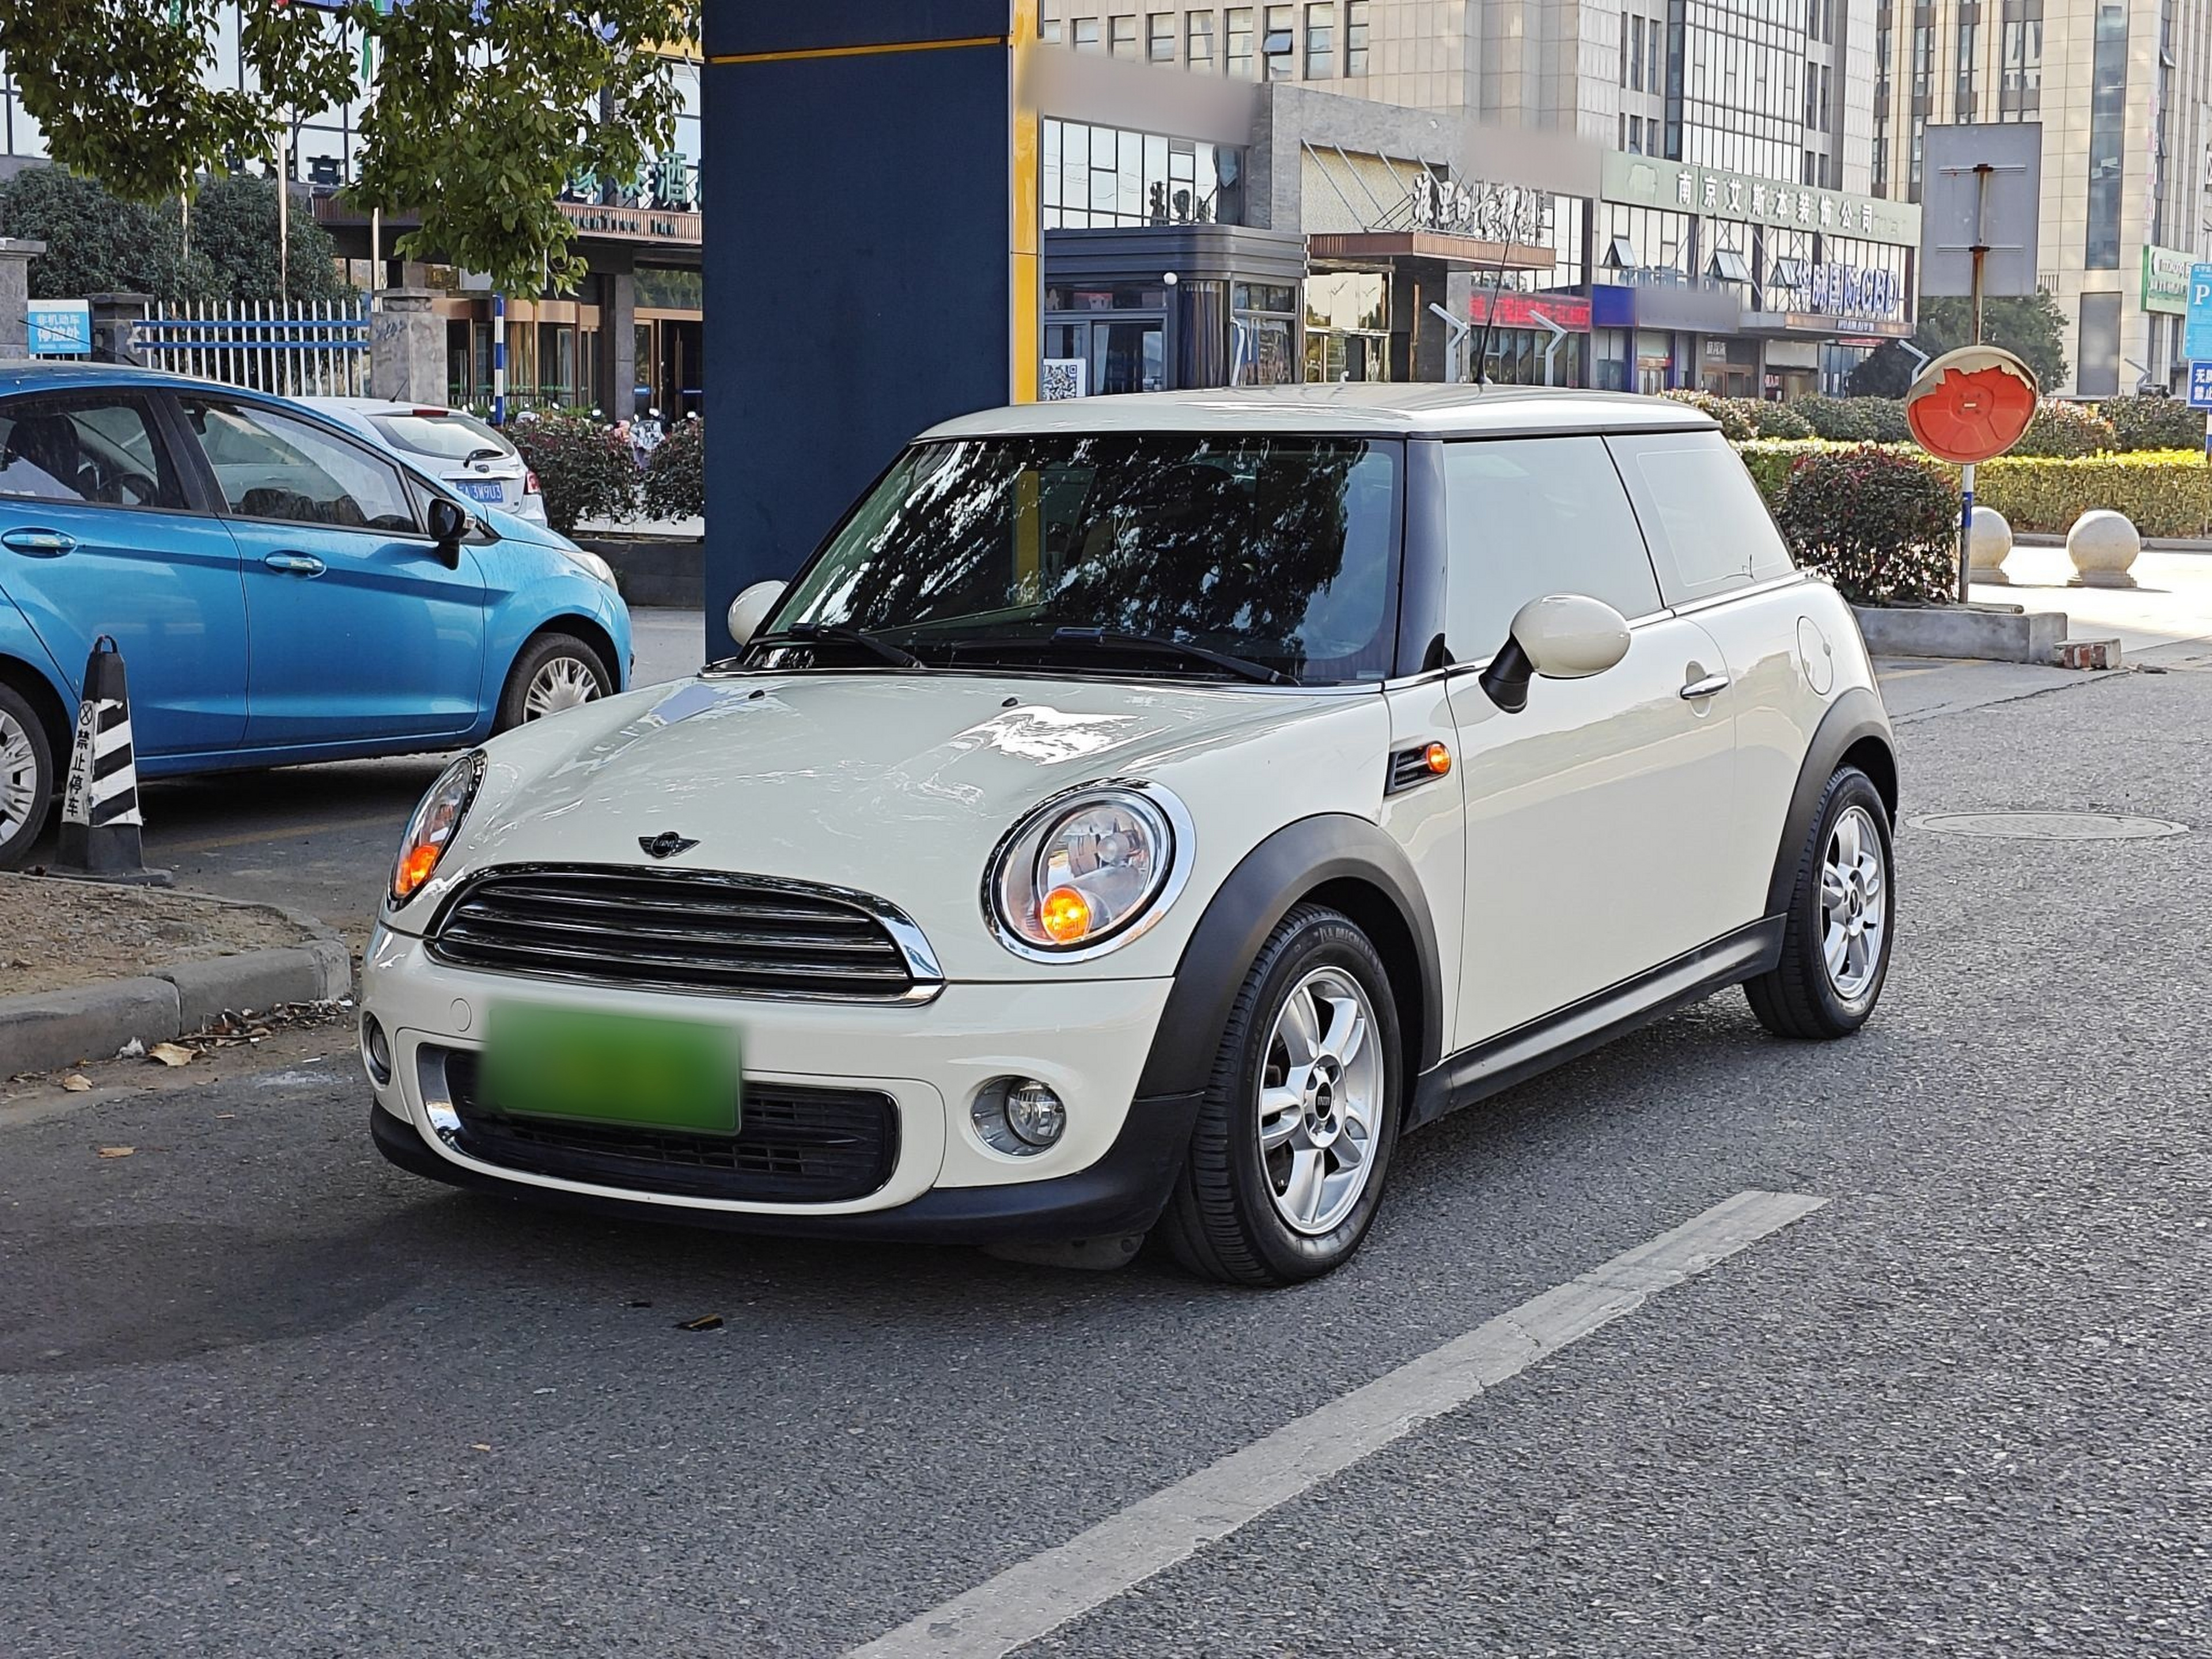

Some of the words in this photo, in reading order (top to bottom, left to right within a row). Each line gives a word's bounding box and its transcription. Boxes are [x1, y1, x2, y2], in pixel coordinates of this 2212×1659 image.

[1677, 170, 1873, 233] 南京艾斯本装饰公司
[2193, 284, 2210, 305] P
[66, 728, 90, 818] 禁止停车
